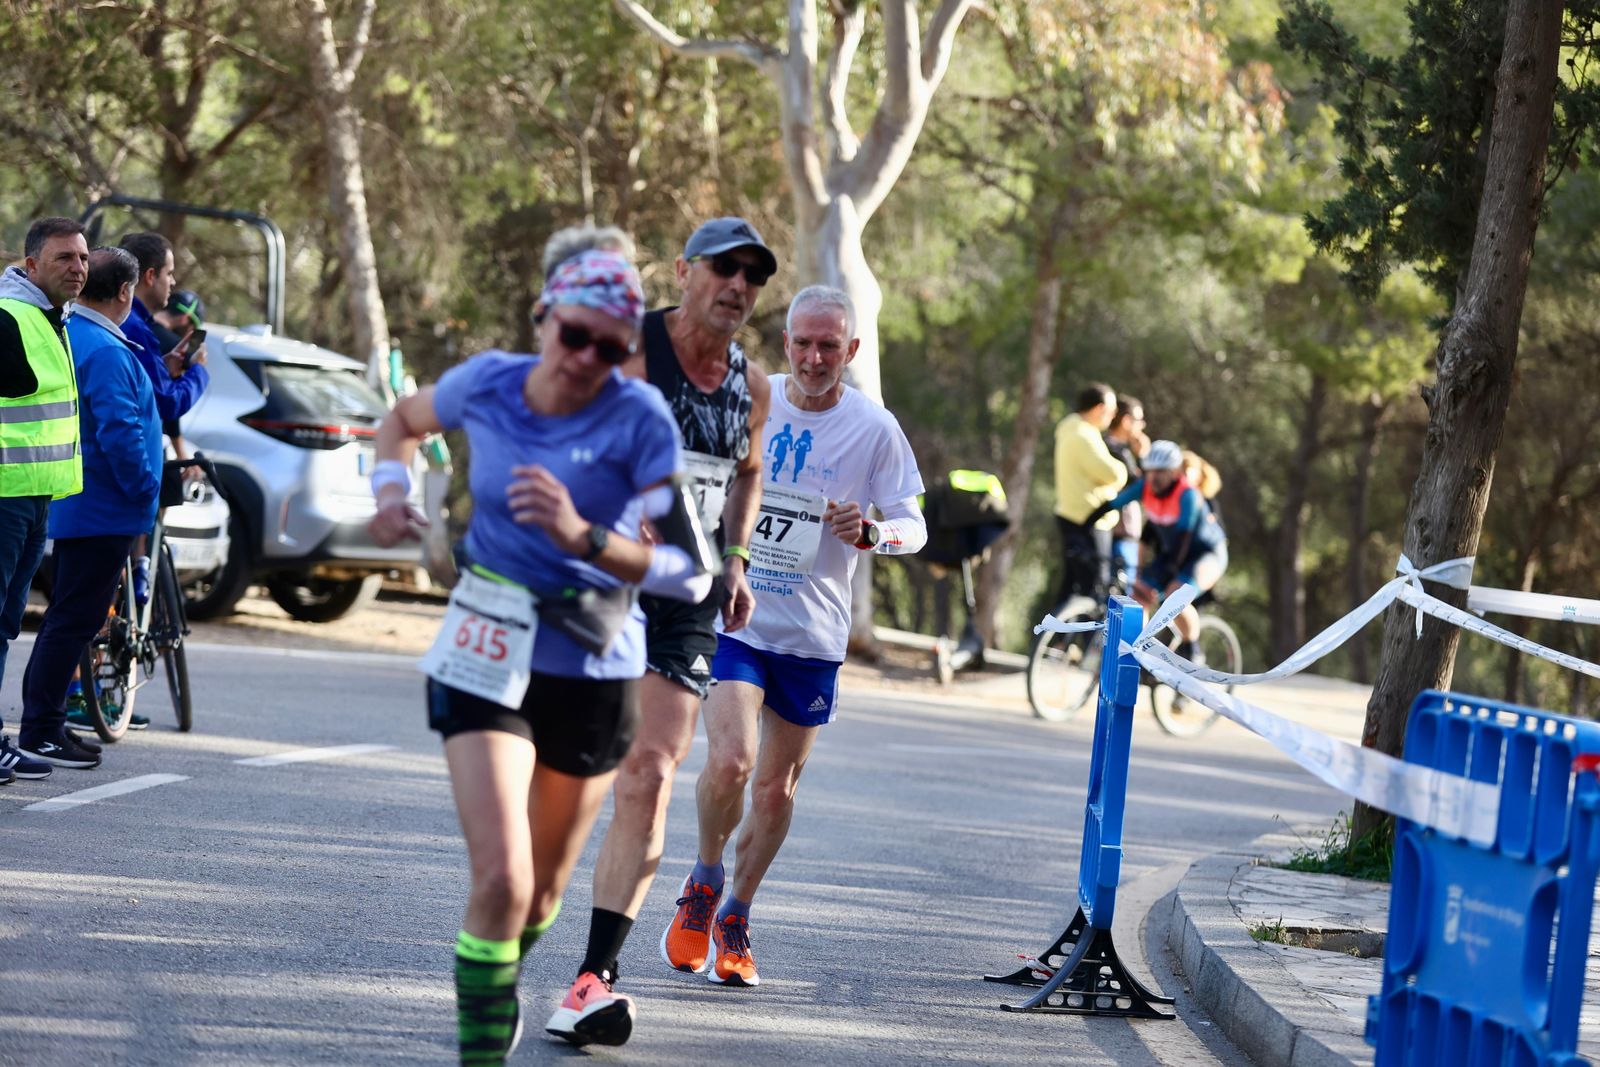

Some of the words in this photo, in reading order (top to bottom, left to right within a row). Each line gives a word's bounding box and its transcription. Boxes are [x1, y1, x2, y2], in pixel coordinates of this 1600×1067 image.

[756, 515, 793, 543] 47
[771, 552, 798, 562] MARATÓN
[772, 560, 796, 569] BASTÓN
[751, 580, 793, 596] Unicaja
[454, 614, 509, 661] 615
